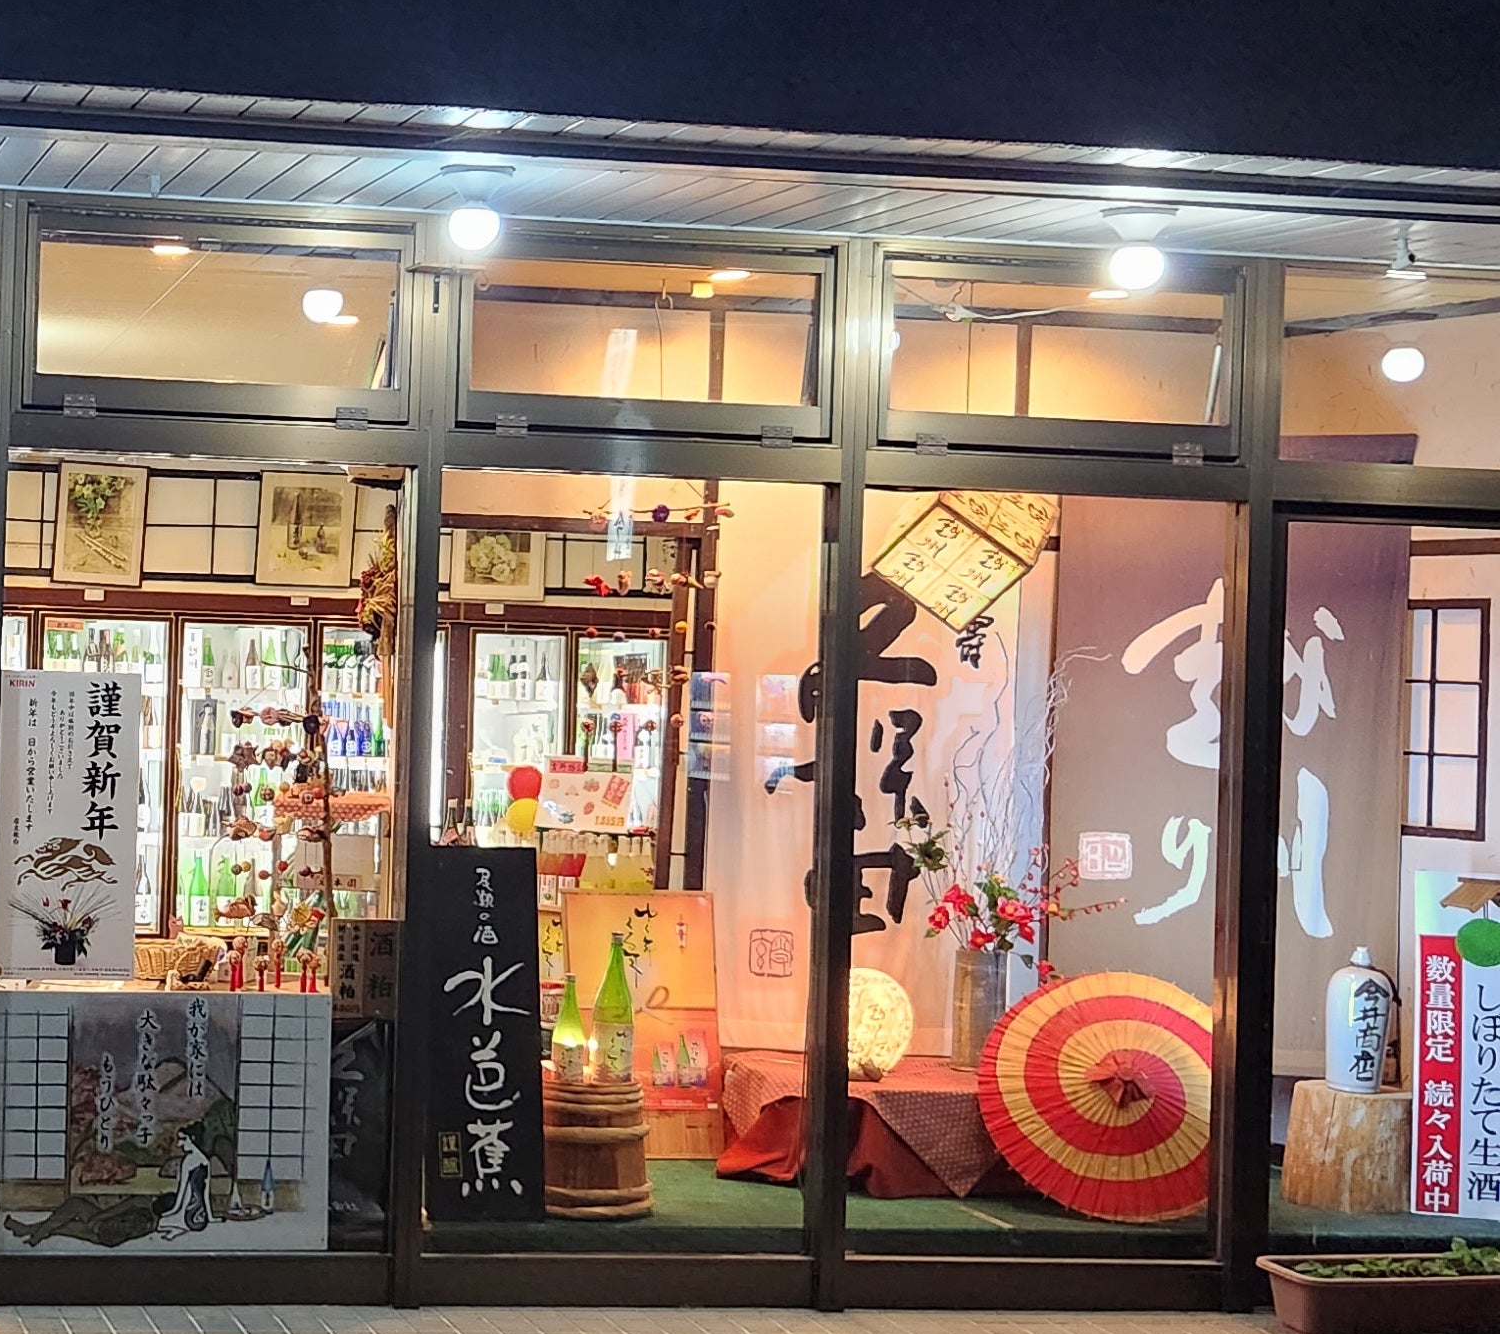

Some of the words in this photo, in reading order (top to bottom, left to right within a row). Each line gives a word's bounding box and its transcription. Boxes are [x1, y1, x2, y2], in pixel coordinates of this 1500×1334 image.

[9, 679, 36, 687] KIRIN
[28, 698, 39, 727] 新年は
[80, 680, 123, 841] 謹賀新年
[187, 998, 206, 1097] 我が家には
[1349, 978, 1390, 1082] 今井商店
[1424, 954, 1456, 1063] 数量限定
[99, 1055, 115, 1149] もうひとり
[137, 1010, 158, 1145] 大きな駄々っ子
[444, 956, 533, 1197] 水芭蕉
[1467, 983, 1500, 1202] しぼりたて生酒
[1422, 1079, 1455, 1213] 続々入荷中
